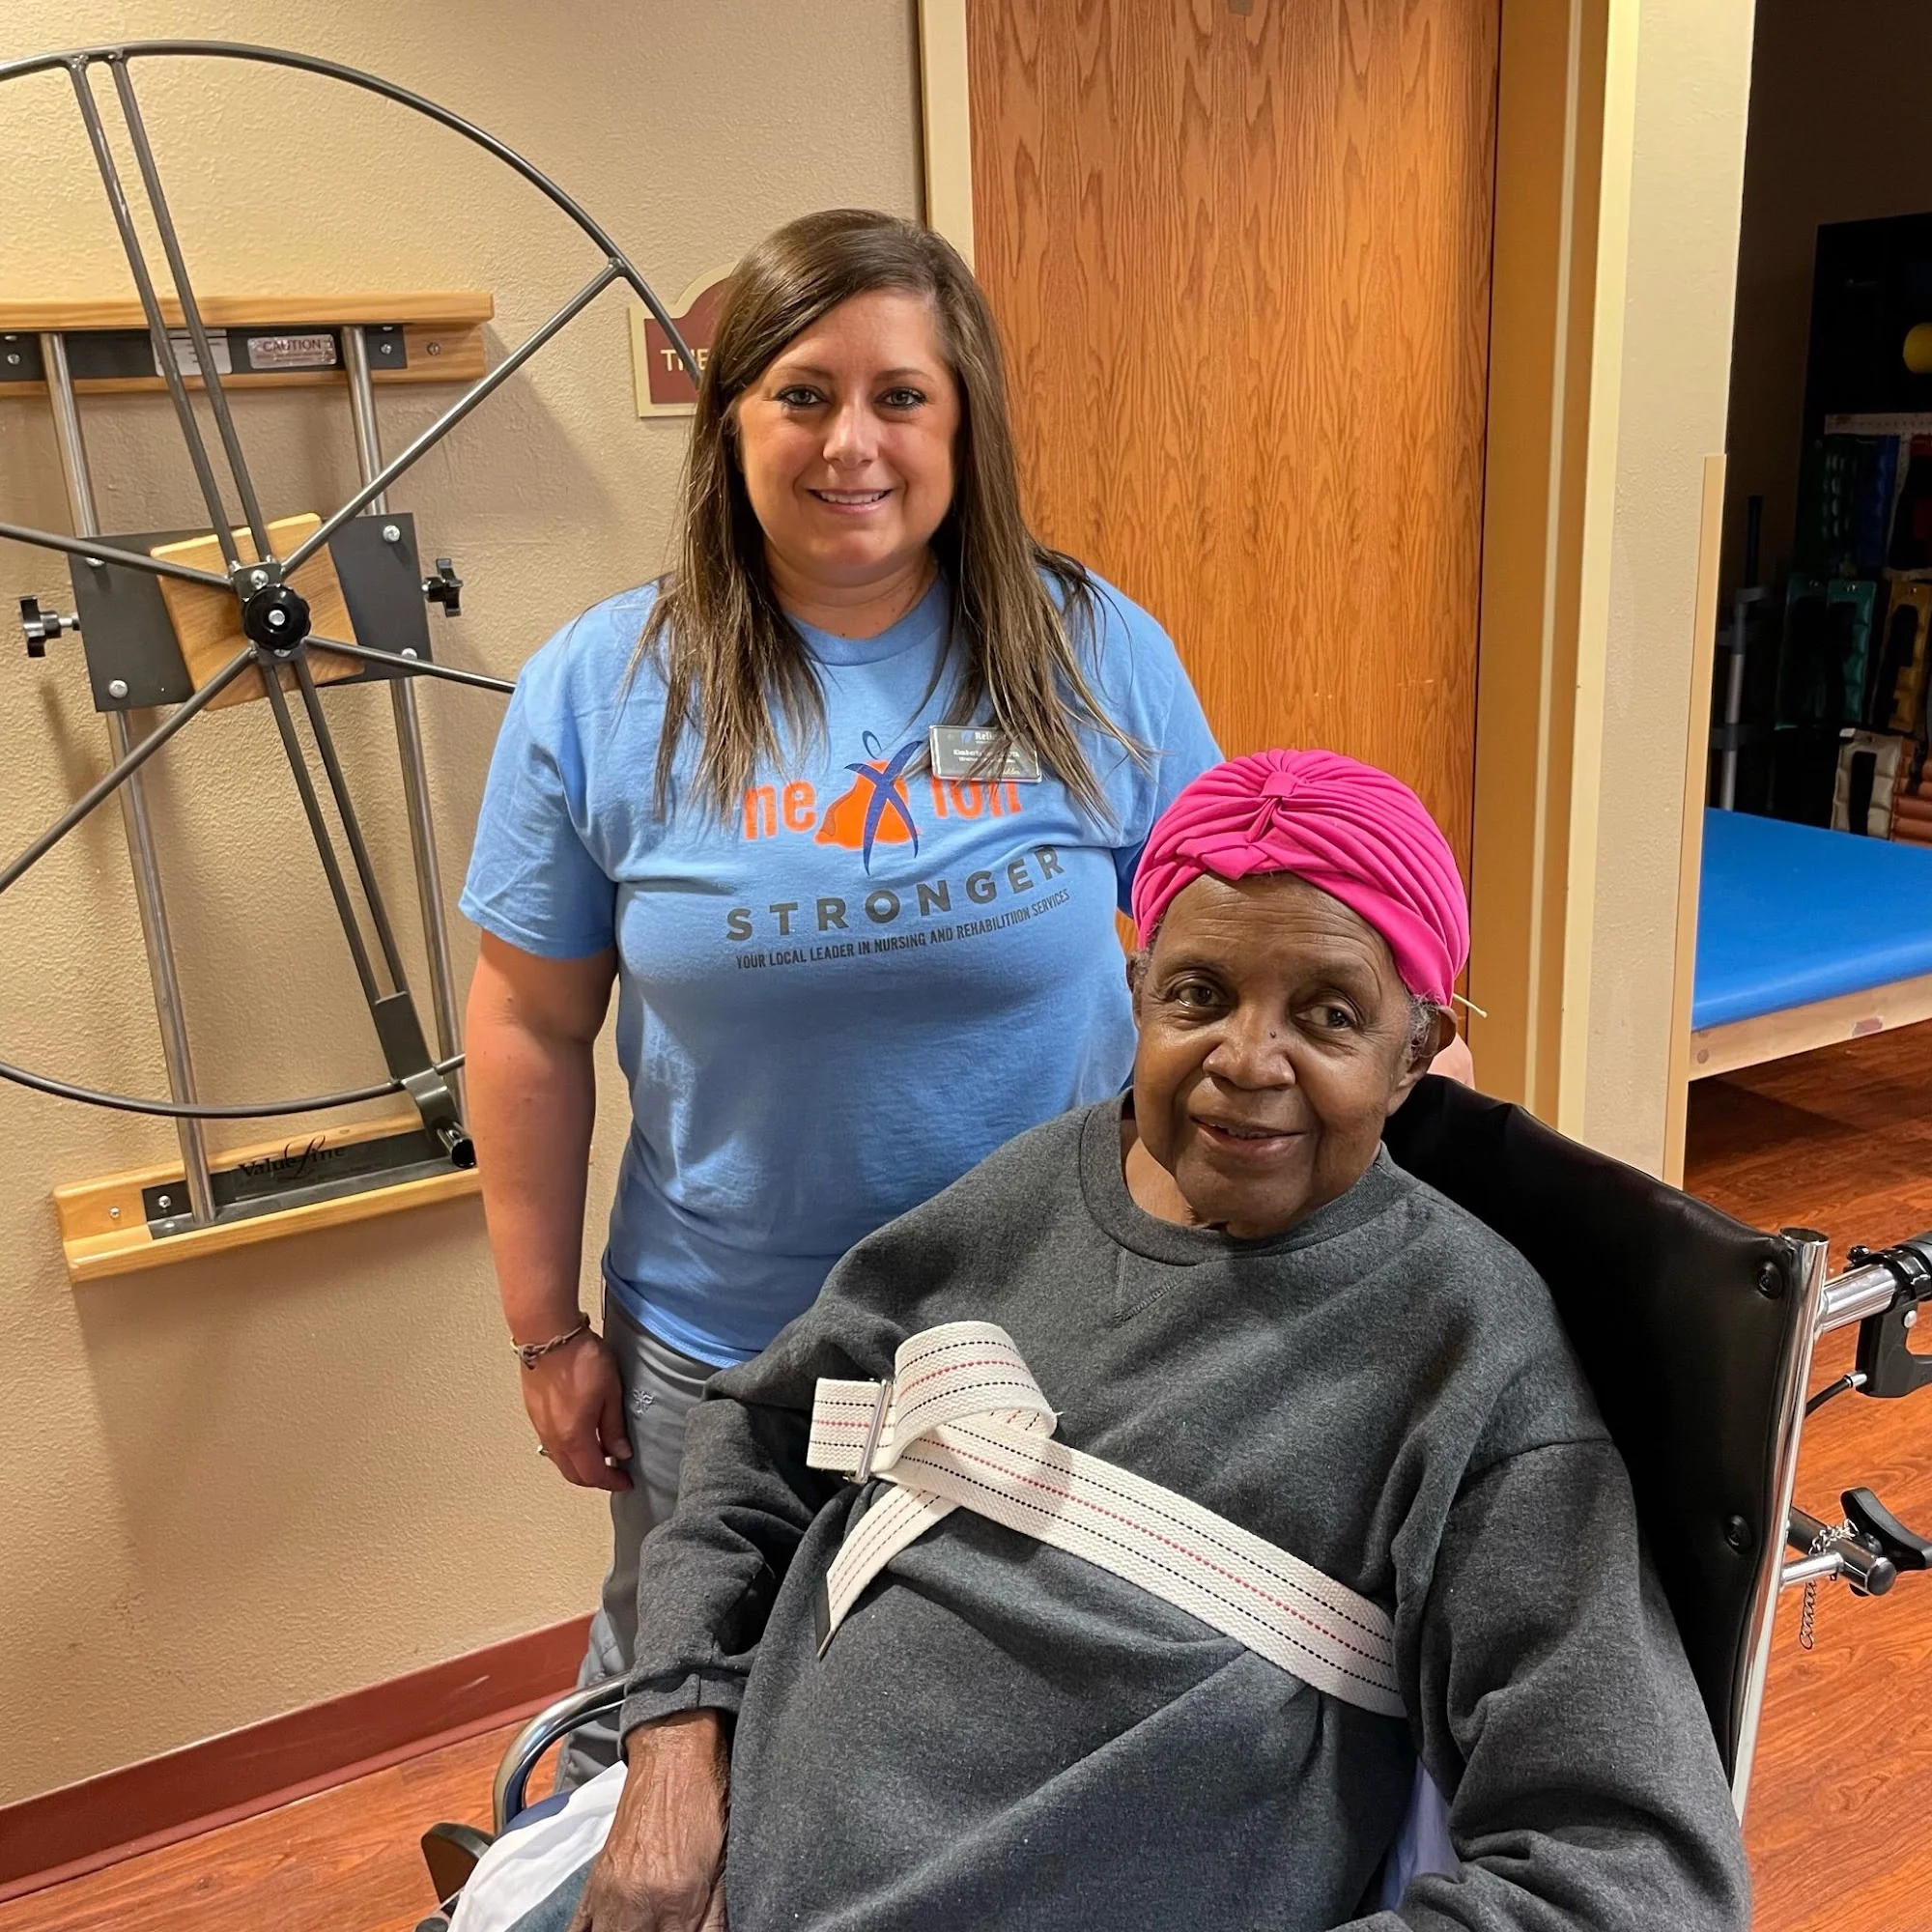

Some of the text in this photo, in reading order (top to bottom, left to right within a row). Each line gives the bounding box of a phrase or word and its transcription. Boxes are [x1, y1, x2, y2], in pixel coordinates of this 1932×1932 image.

[262, 339, 322, 353] CAUTION
[725, 846, 1065, 941] STRONGER
[736, 953, 766, 970] YOUR
[769, 949, 808, 966] LOCAL
[810, 943, 855, 961] LEADER
[858, 941, 871, 955] IN
[874, 931, 926, 953] NURSING
[929, 925, 953, 944] AND
[1032, 888, 1070, 917] SERVICES
